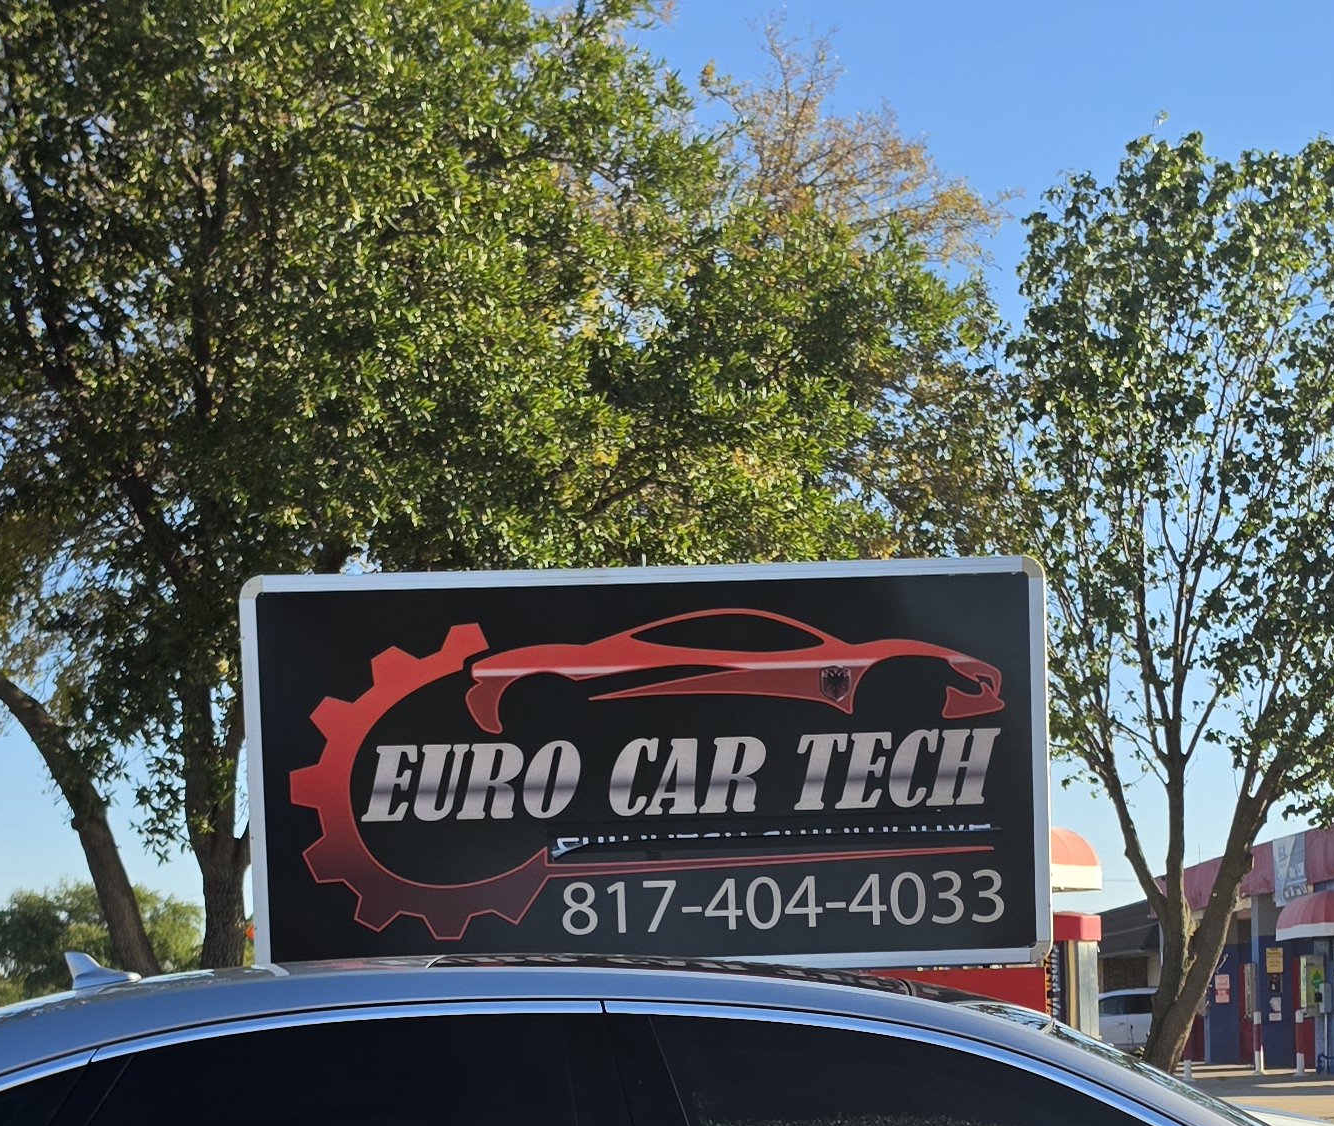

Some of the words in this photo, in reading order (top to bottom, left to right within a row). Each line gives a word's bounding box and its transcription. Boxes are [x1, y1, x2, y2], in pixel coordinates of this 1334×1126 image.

[361, 740, 581, 823] EURO
[609, 736, 768, 818] CAR
[795, 727, 1002, 811] TECH
[562, 869, 1006, 936] 817-404-4033
